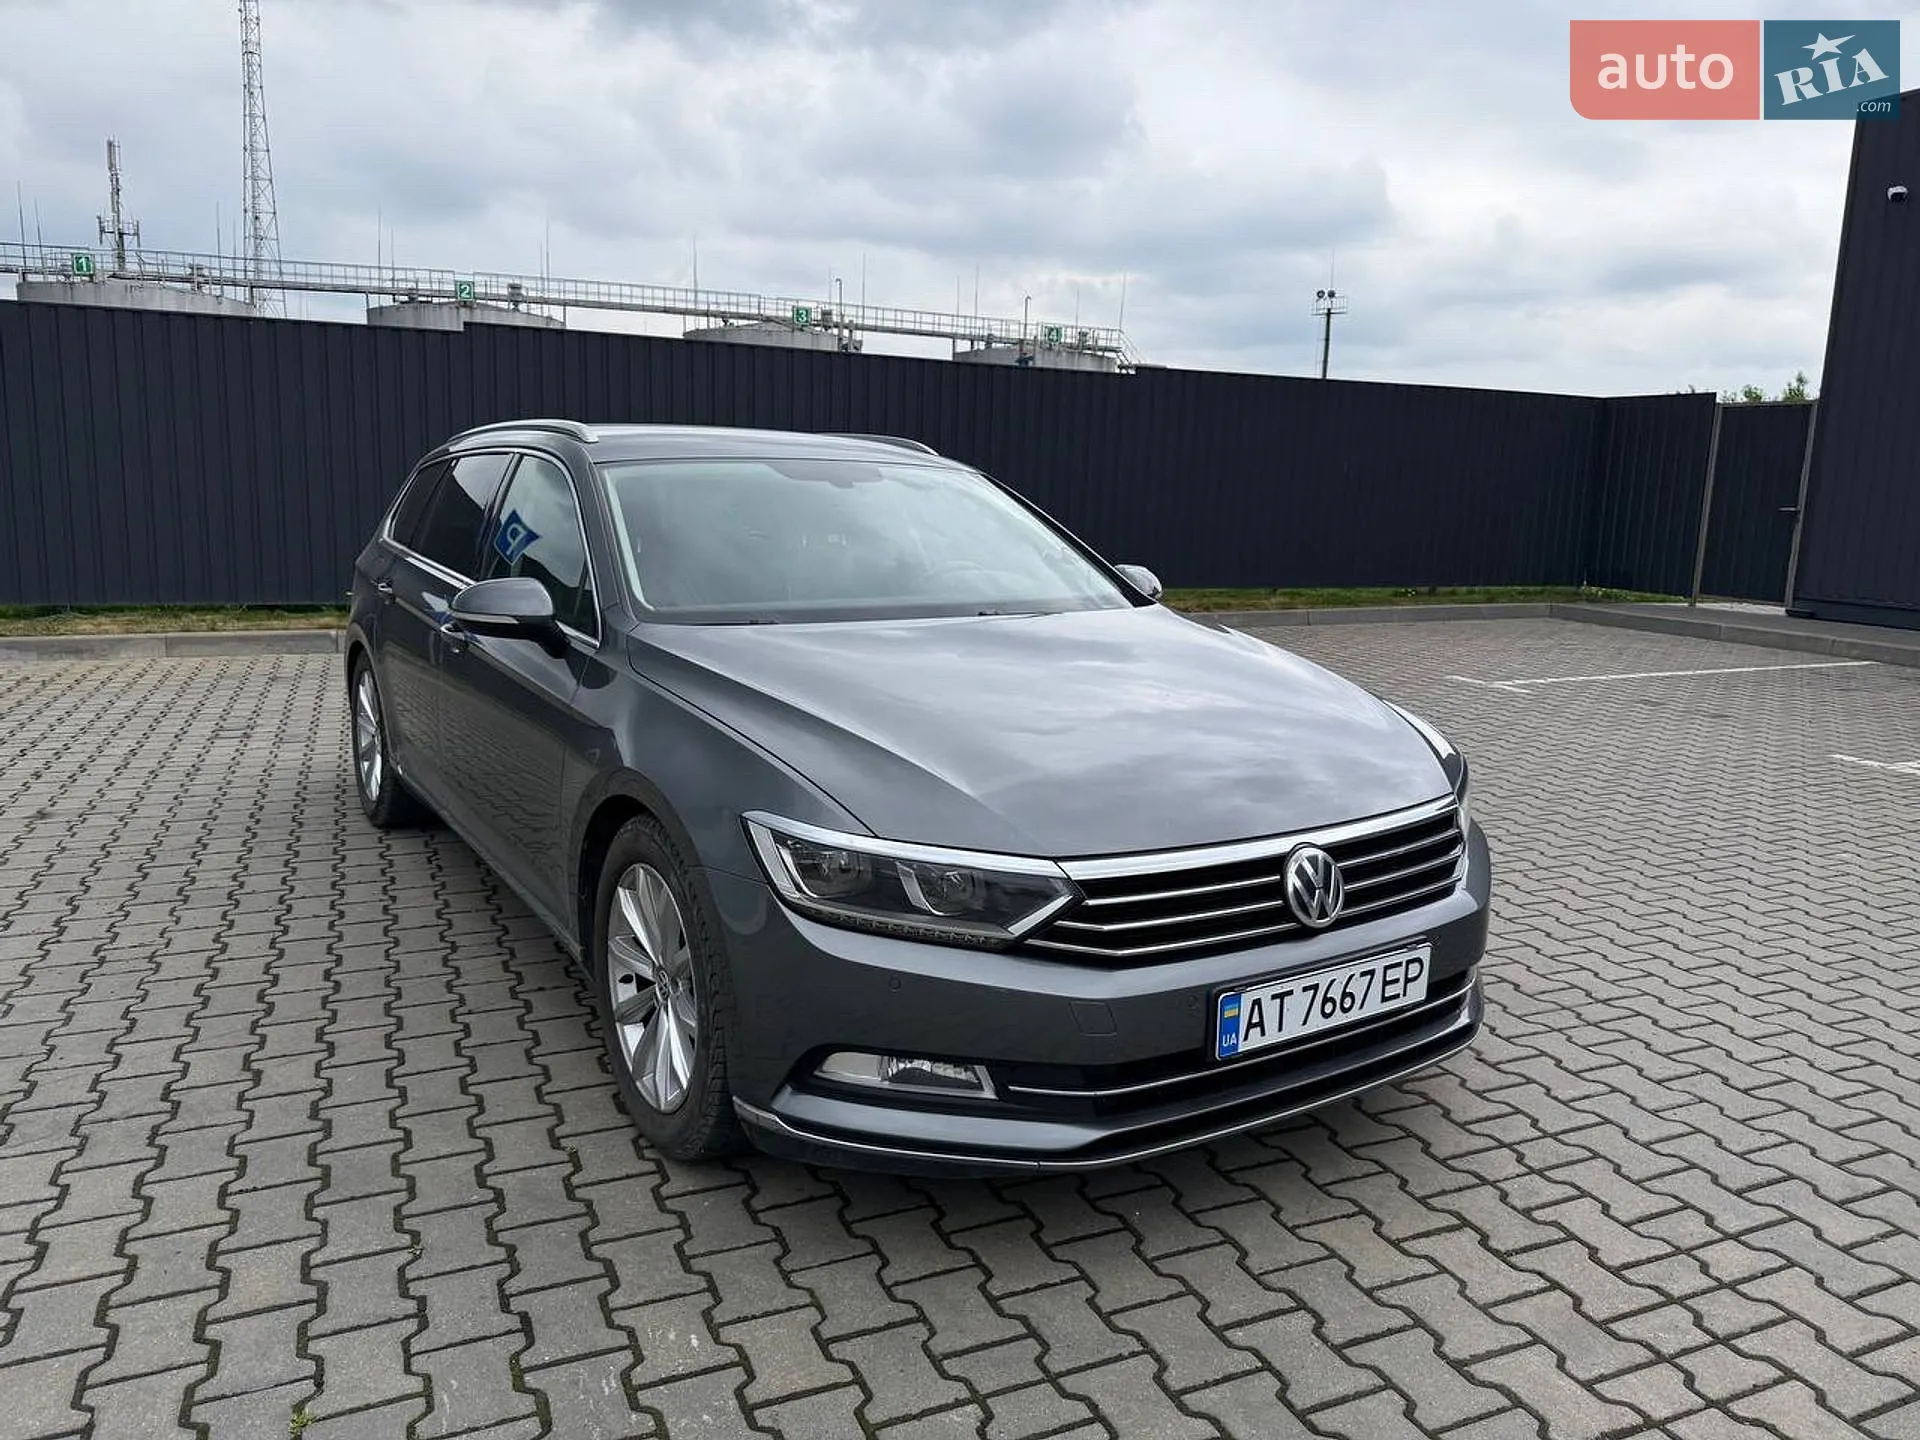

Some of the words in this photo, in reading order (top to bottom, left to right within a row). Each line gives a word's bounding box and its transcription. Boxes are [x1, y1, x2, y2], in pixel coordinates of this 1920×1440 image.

[79, 256, 87, 272] 1
[460, 284, 470, 298] 2
[798, 310, 807, 322] 3
[1049, 328, 1058, 342] 4
[1287, 850, 1342, 925] VW
[1242, 988, 1295, 1042] AT
[1301, 968, 1377, 1027] 7667
[1380, 956, 1425, 1004] EP
[1222, 1032, 1238, 1047] UA
